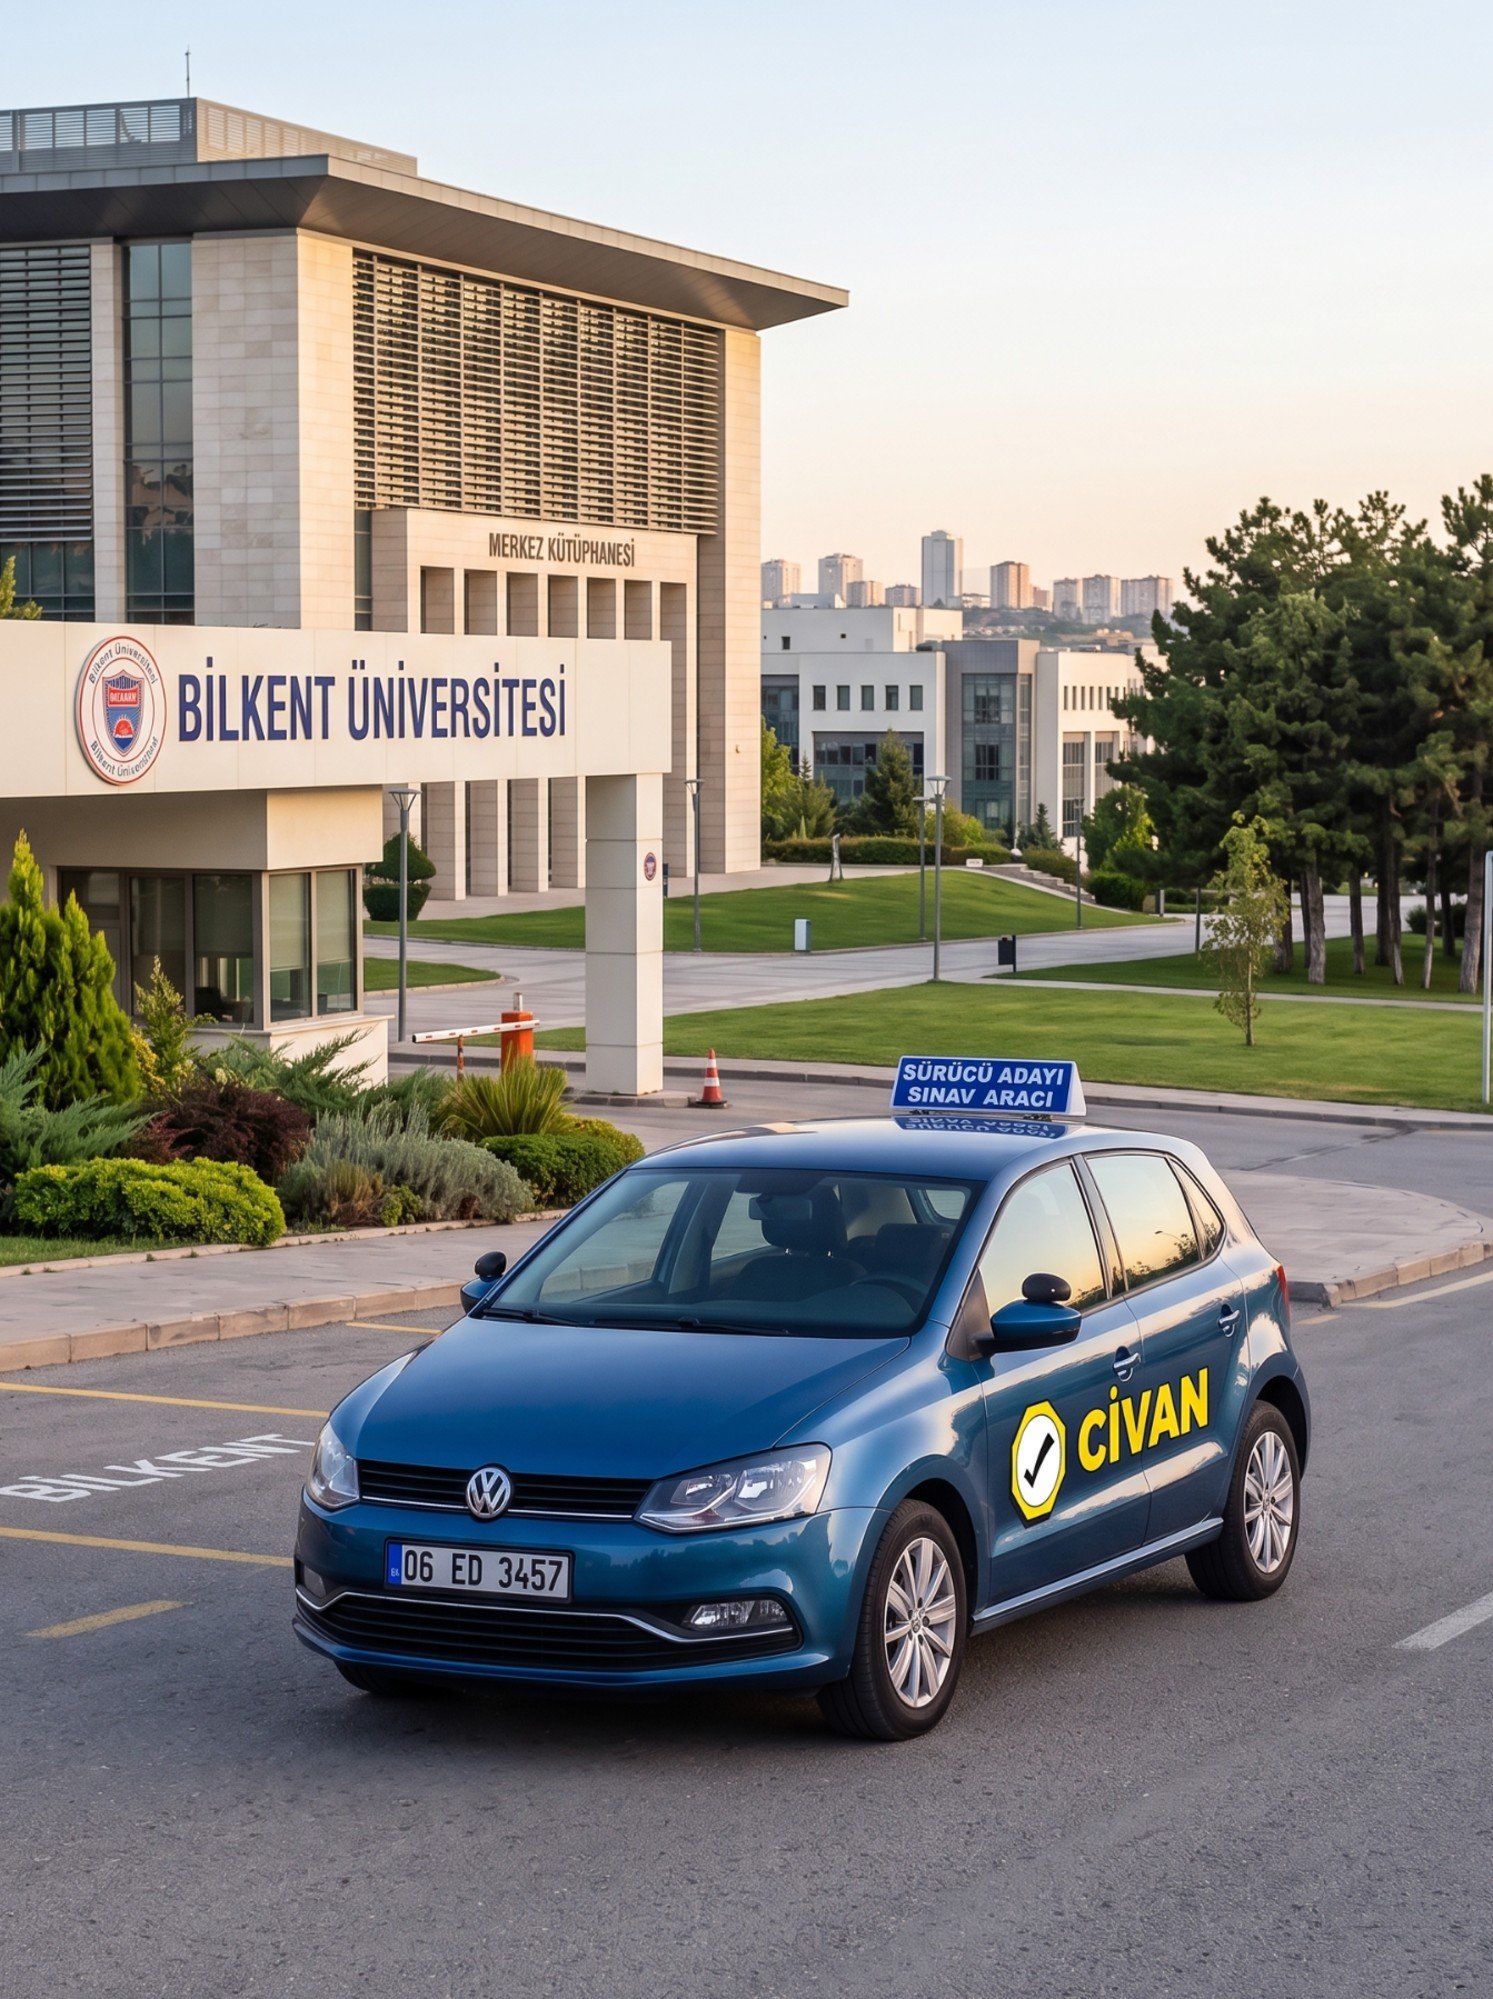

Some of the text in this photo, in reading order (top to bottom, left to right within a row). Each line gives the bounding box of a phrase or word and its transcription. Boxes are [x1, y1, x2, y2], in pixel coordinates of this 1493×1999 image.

[489, 532, 635, 567] MERKEZ KÜTÜPHANESİ
[178, 656, 565, 742] BİLKENT ÜNİVERSİTESİ
[903, 1060, 1064, 1085] SÜRÜCÜ ADAYI
[907, 1086, 1053, 1107] SINAV ARACI
[1077, 1367, 1209, 1472] CİVAN
[404, 1549, 563, 1592] 06 ED 3457
